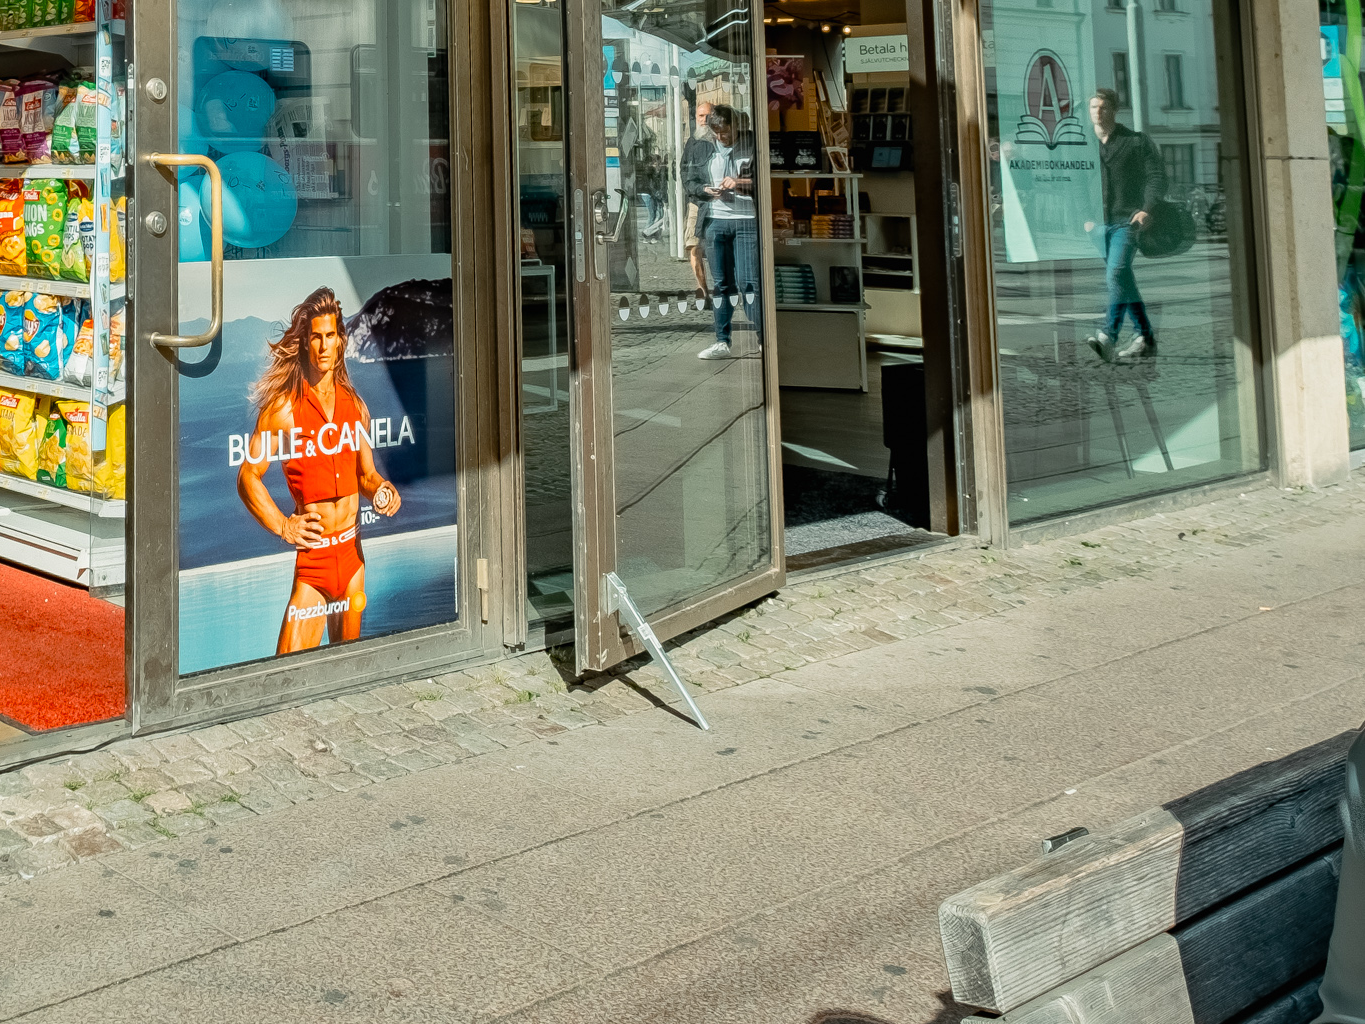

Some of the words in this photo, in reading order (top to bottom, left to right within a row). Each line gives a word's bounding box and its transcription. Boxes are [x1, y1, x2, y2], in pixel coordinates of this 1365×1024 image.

[859, 44, 896, 56] Betala
[1009, 159, 1095, 170] AKADEMIBOKHANDELN
[25, 222, 45, 237] NGS
[228, 427, 303, 467] BULLE
[305, 440, 317, 458] &
[317, 415, 416, 456] CANELA
[361, 511, 381, 526] 10:-
[288, 597, 351, 622] Prezzburoni
